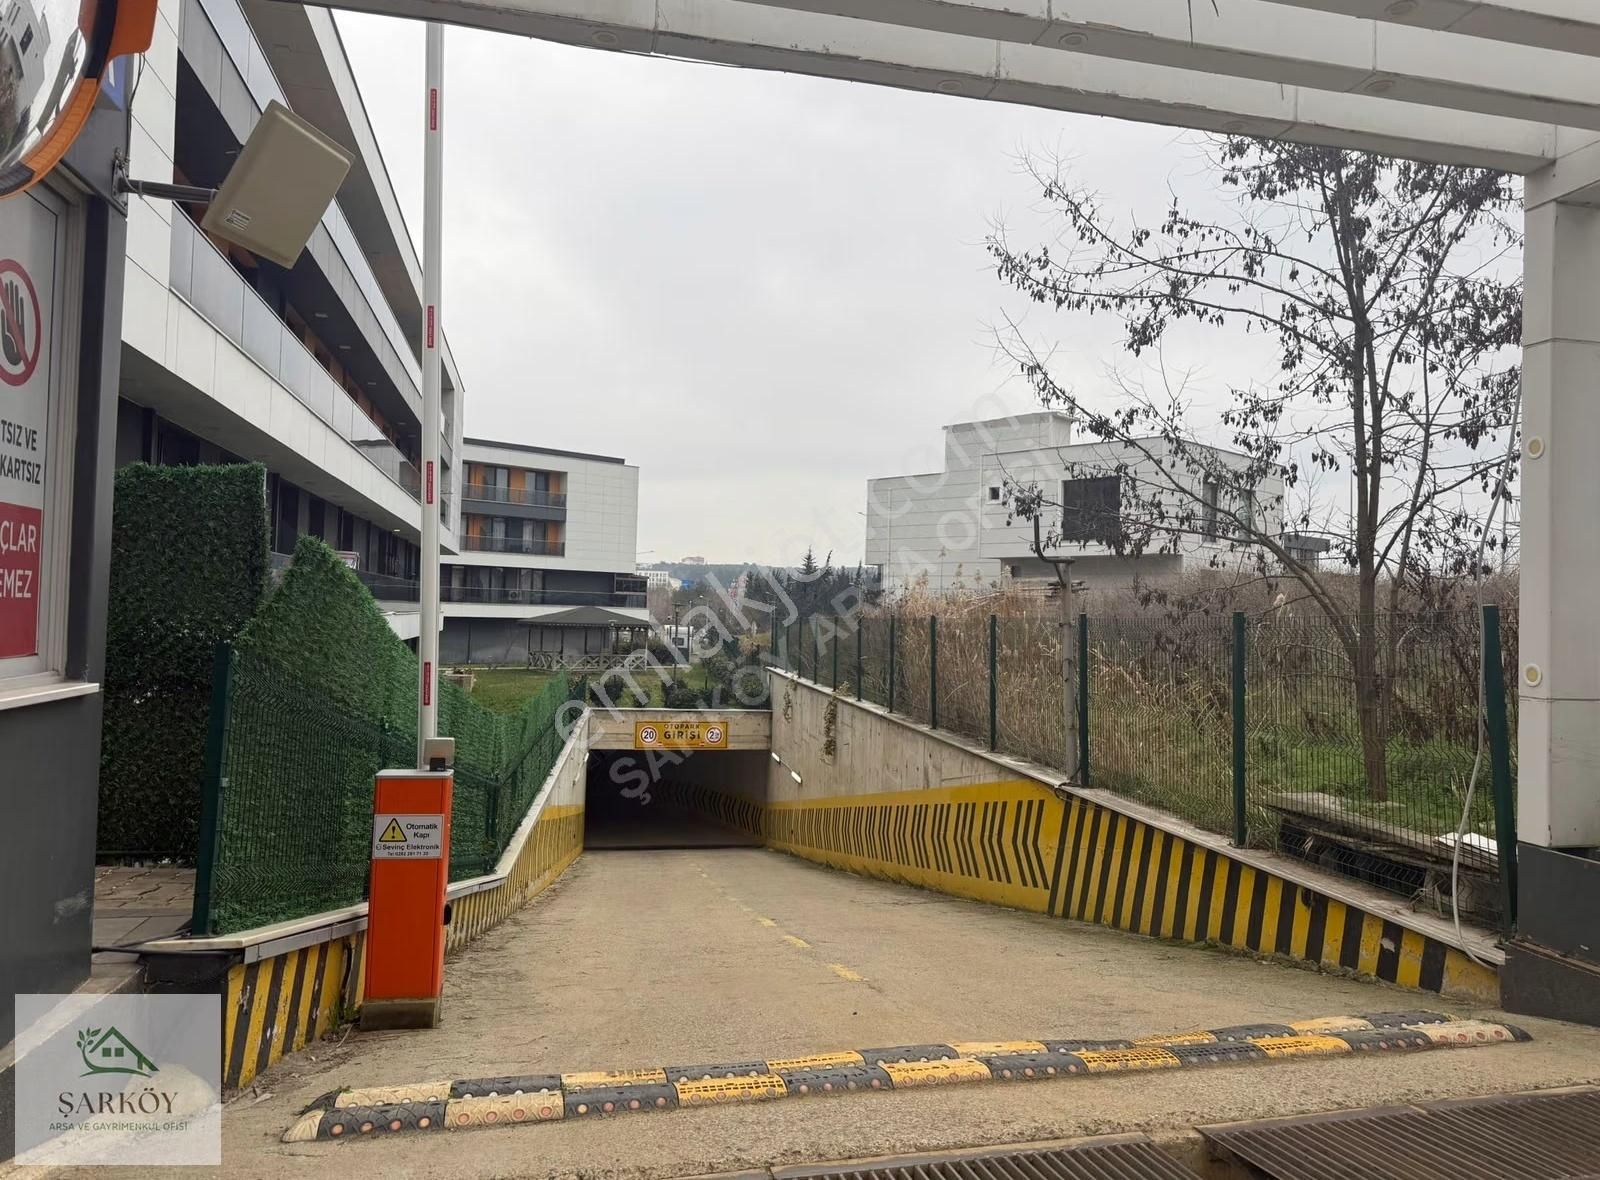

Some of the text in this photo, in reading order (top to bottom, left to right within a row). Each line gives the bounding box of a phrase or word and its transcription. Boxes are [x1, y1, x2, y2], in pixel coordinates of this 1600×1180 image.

[25, 427, 37, 451] VE
[0, 454, 41, 485] KARTSIZ
[643, 730, 654, 740] 20
[413, 831, 430, 840] Kapı
[382, 843, 405, 851] Sevinç
